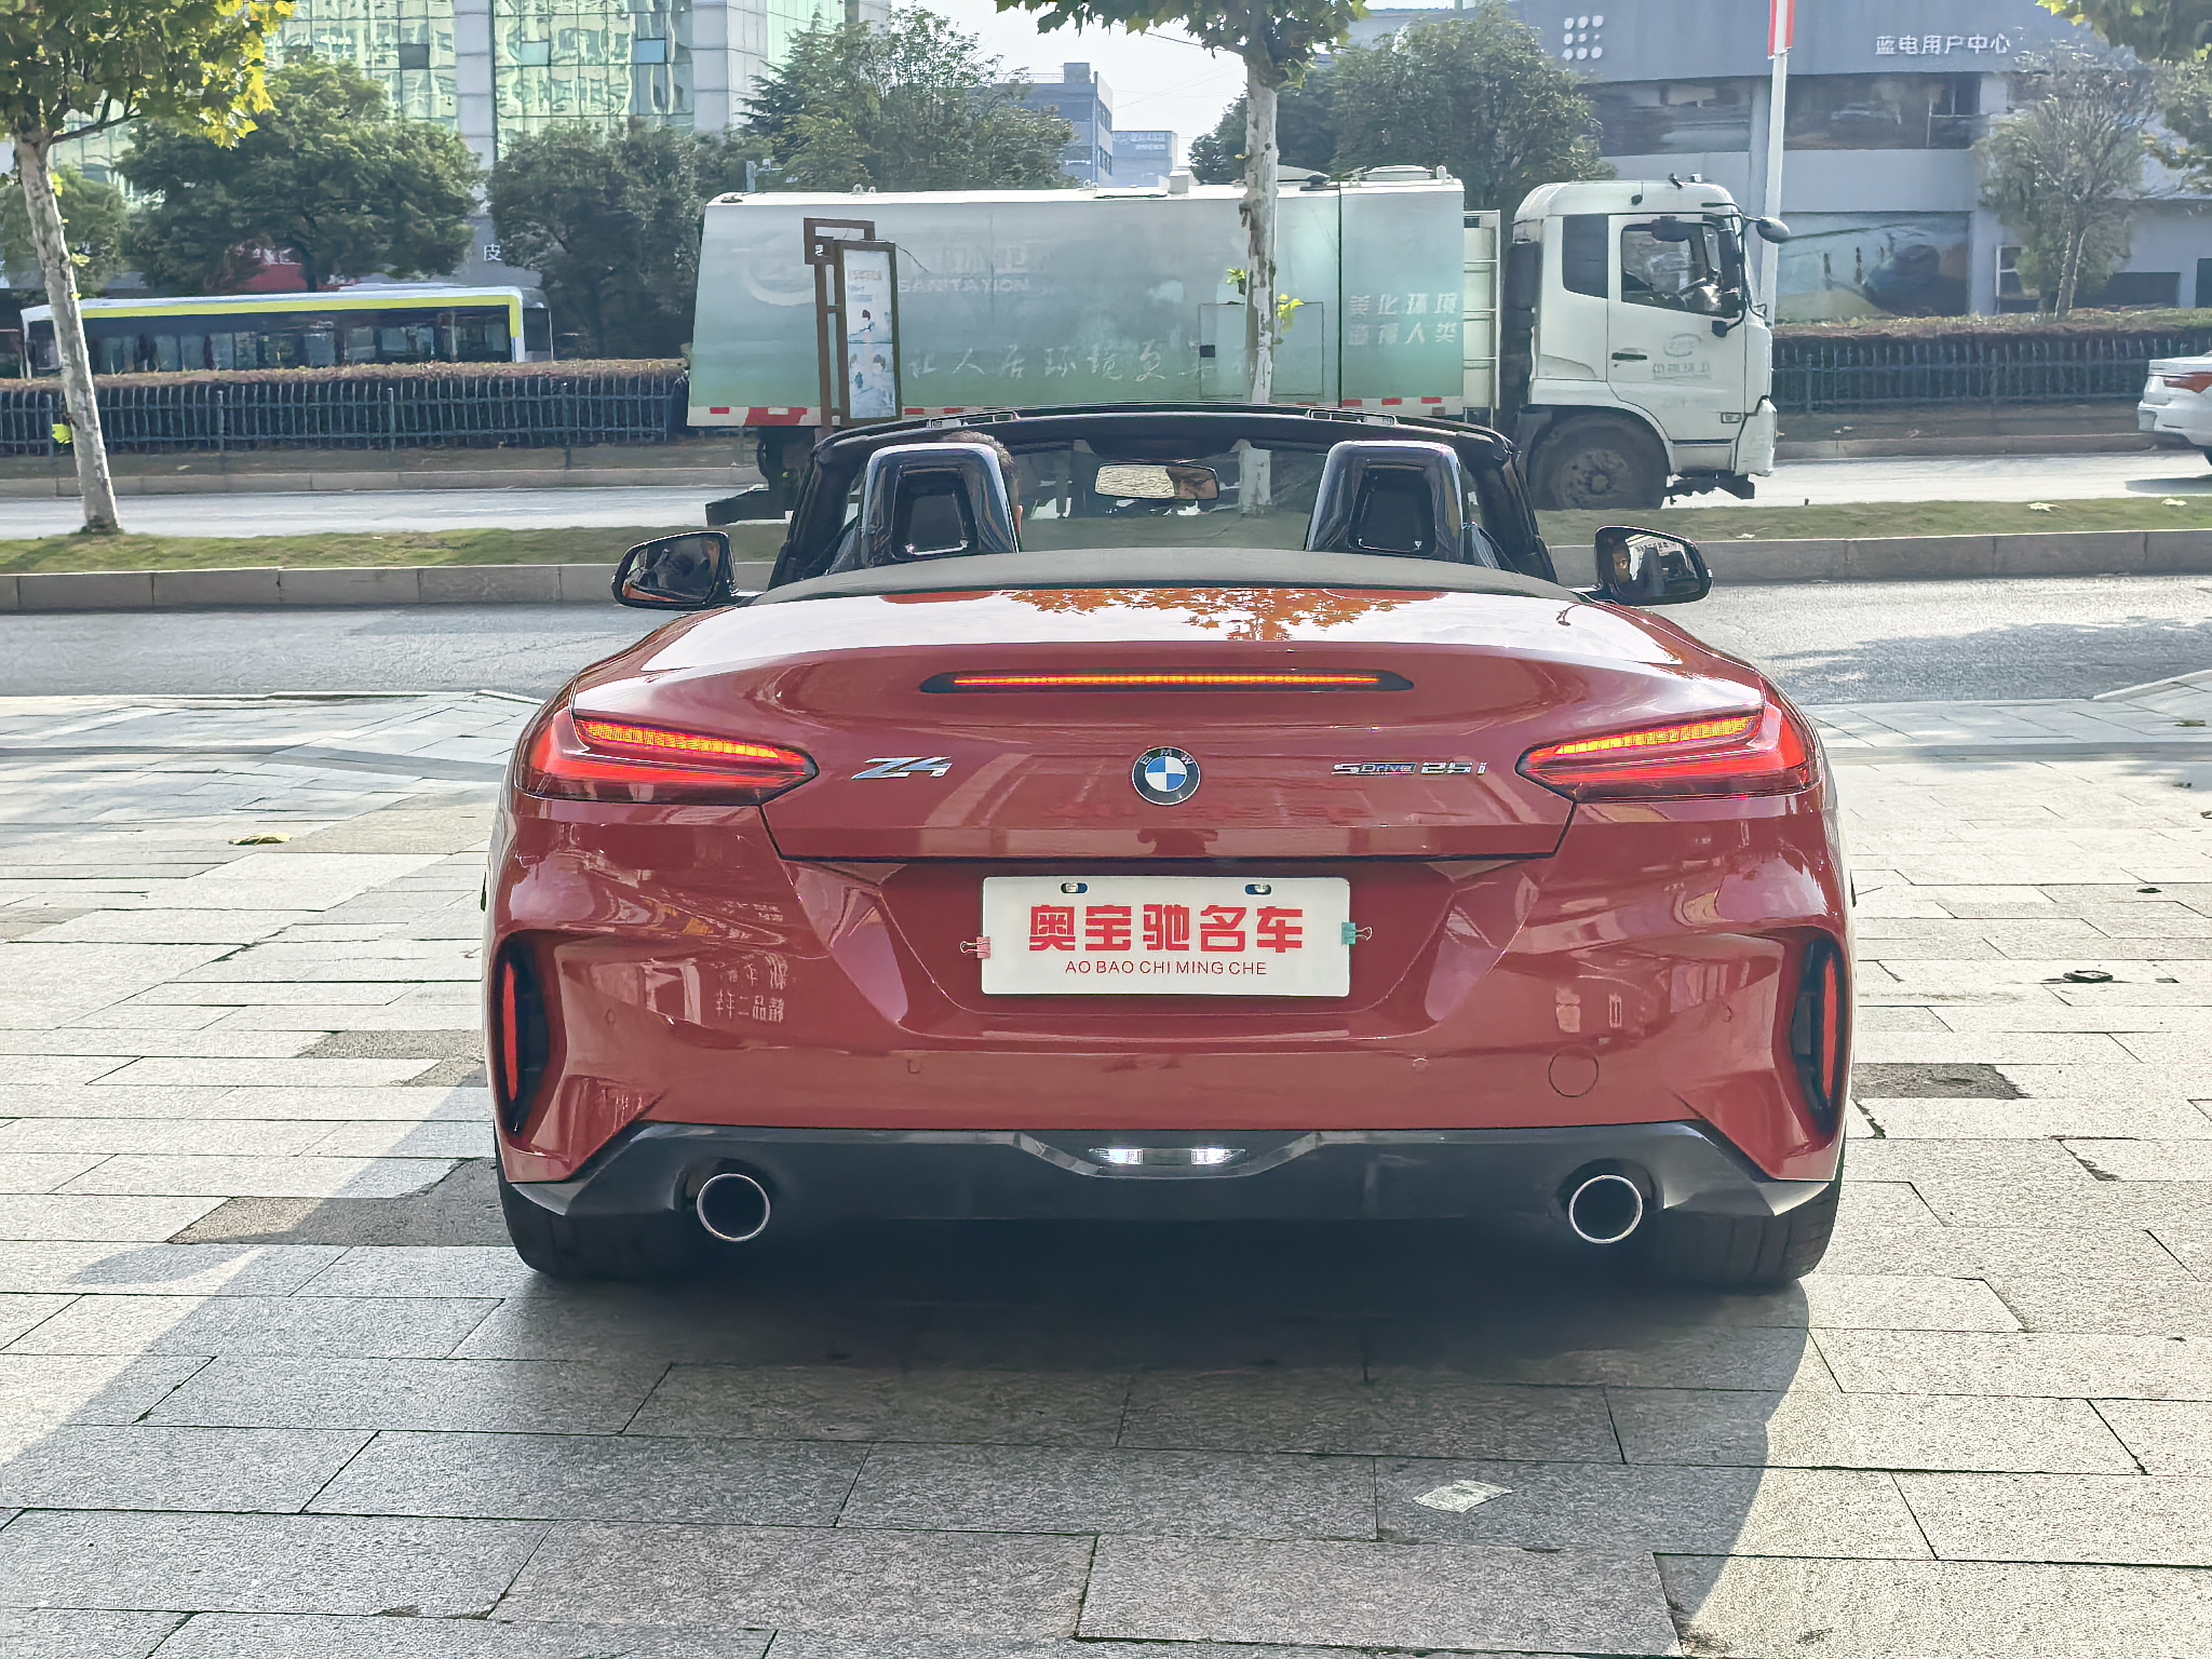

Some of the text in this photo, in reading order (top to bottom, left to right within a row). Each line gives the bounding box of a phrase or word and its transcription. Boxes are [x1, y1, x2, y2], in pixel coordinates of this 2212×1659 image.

[1875, 32, 2011, 55] 蓝电用户中心
[851, 756, 952, 779] Z4
[1139, 748, 1194, 765] BMW
[1029, 904, 1303, 953] 奥宝驰名车
[1065, 961, 1267, 975] AO BAO CHI MING CHE
